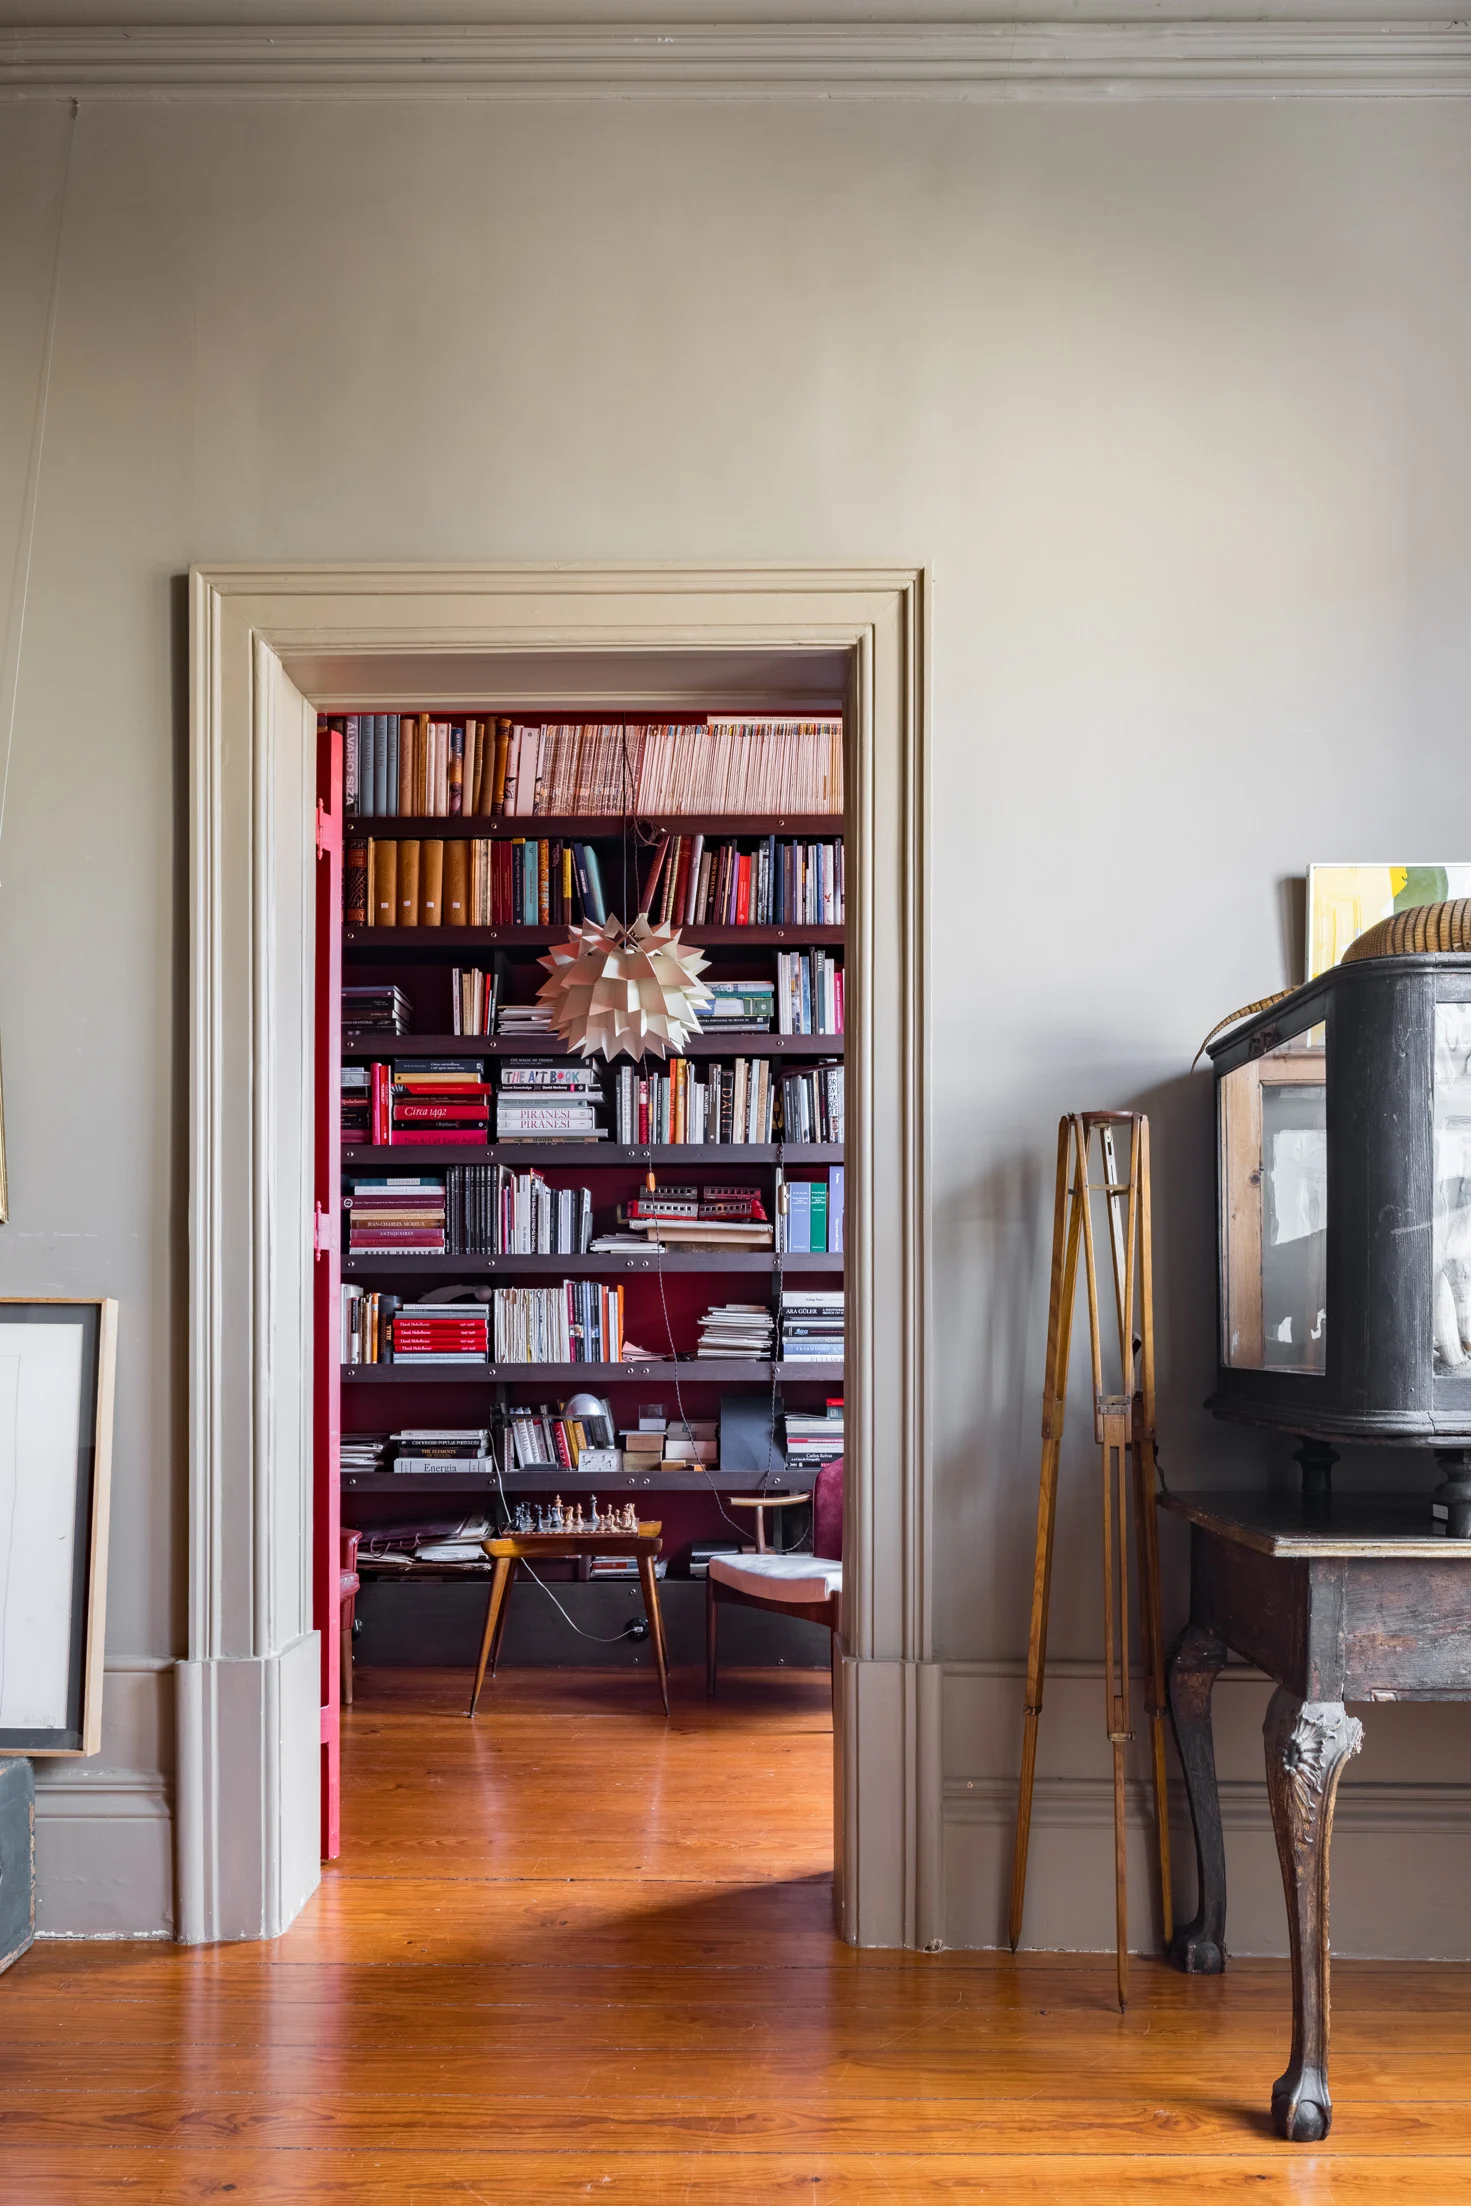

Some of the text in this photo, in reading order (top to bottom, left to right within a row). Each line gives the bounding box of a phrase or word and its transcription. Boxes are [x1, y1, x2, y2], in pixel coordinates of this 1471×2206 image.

[345, 721, 357, 805] ÁLVARO SIZA
[505, 1071, 526, 1084] THE
[550, 1071, 580, 1084] BOOK
[404, 1106, 447, 1118] Circa 1492
[520, 1110, 570, 1119] PIRANESI
[520, 1120, 570, 1128] PIRANESI
[404, 1137, 478, 1145] The Art of East Asia
[555, 1431, 567, 1466] VENEZA
[424, 1463, 457, 1473] Energia
